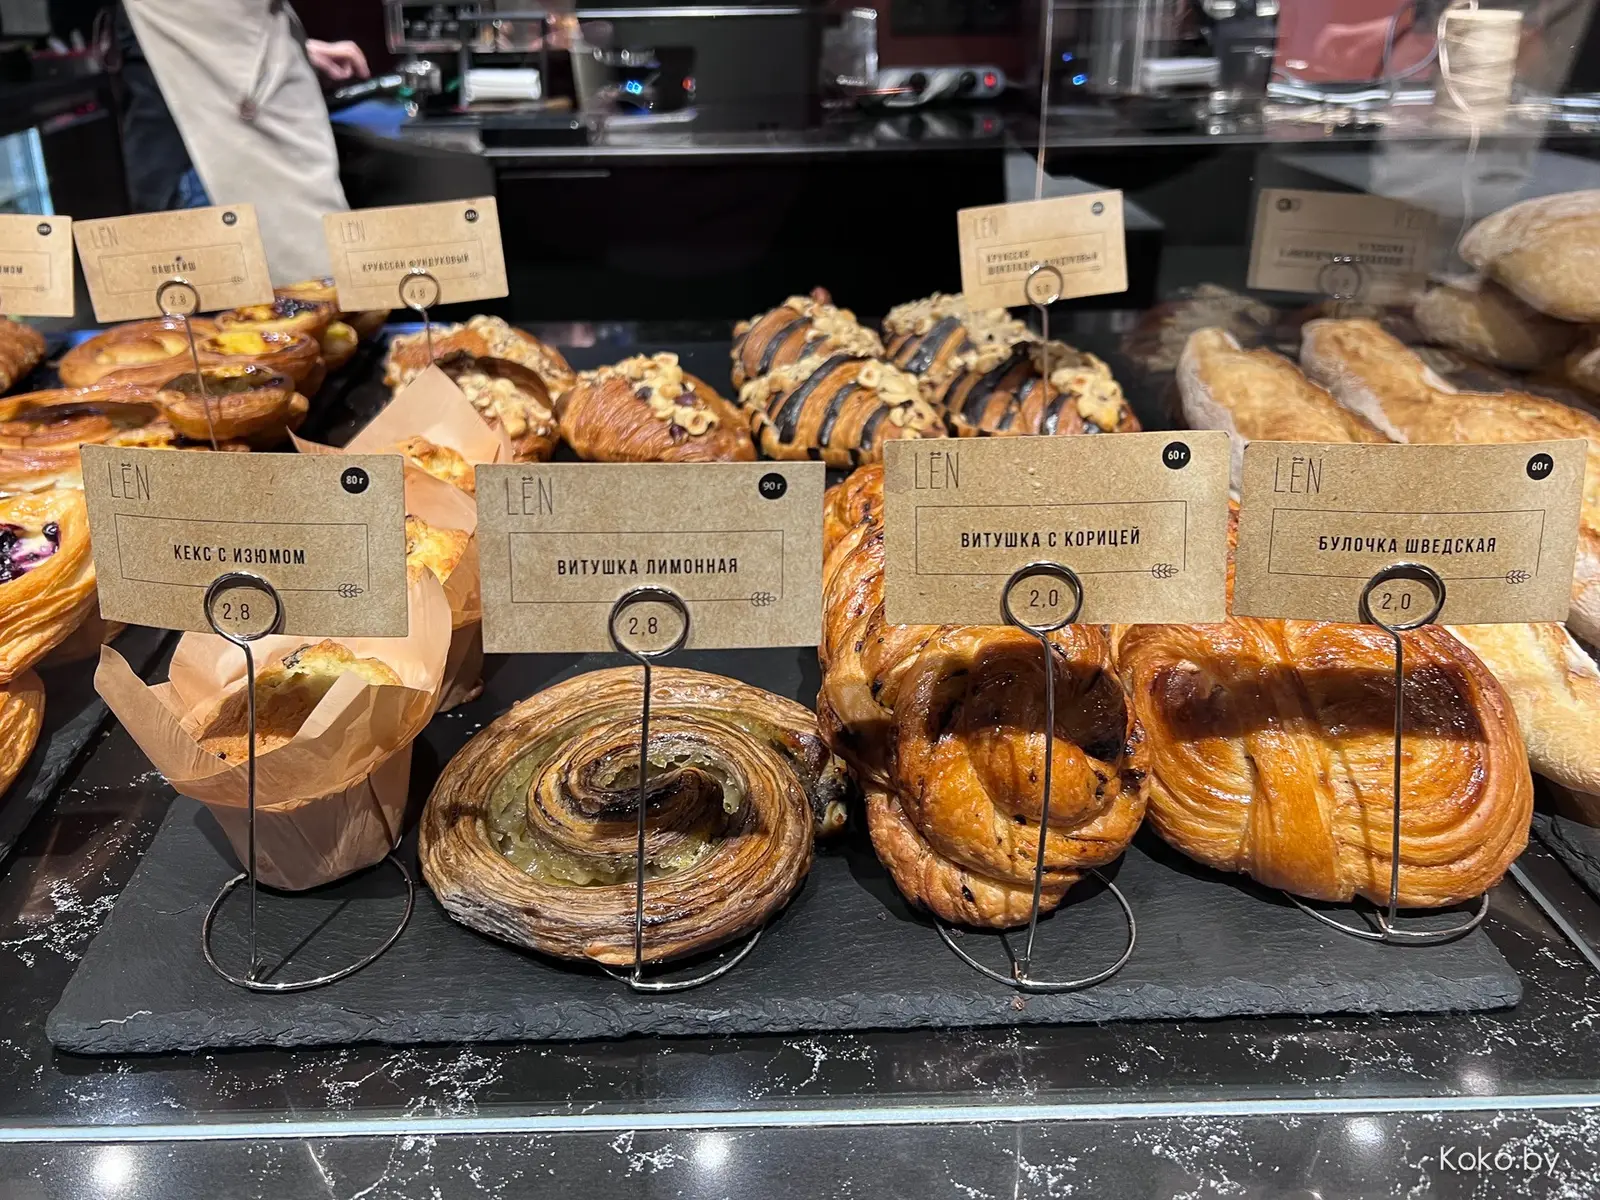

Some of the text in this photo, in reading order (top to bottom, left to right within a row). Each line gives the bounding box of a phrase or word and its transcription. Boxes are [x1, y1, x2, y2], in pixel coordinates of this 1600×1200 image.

[362, 252, 471, 273] КРУАССАН ФУНДУКОВЫЙ
[1167, 450, 1180, 460] 60
[1531, 461, 1543, 471] 60
[345, 475, 357, 486] 80
[762, 481, 776, 491] 90
[961, 526, 1141, 548] ВИТУШКА С КОРИЦЕЙ
[1318, 535, 1497, 555] БУЛОЧКА ШВЕДСКАЯ
[173, 544, 306, 565] КЕКС С ИЗЮМОМ
[557, 557, 739, 576] ВИТУШКА ЛИМОННАЯ
[1029, 589, 1059, 609] 2,0
[1381, 592, 1412, 611] 2,0
[222, 602, 251, 623] 2,8
[628, 616, 659, 638] 2,8
